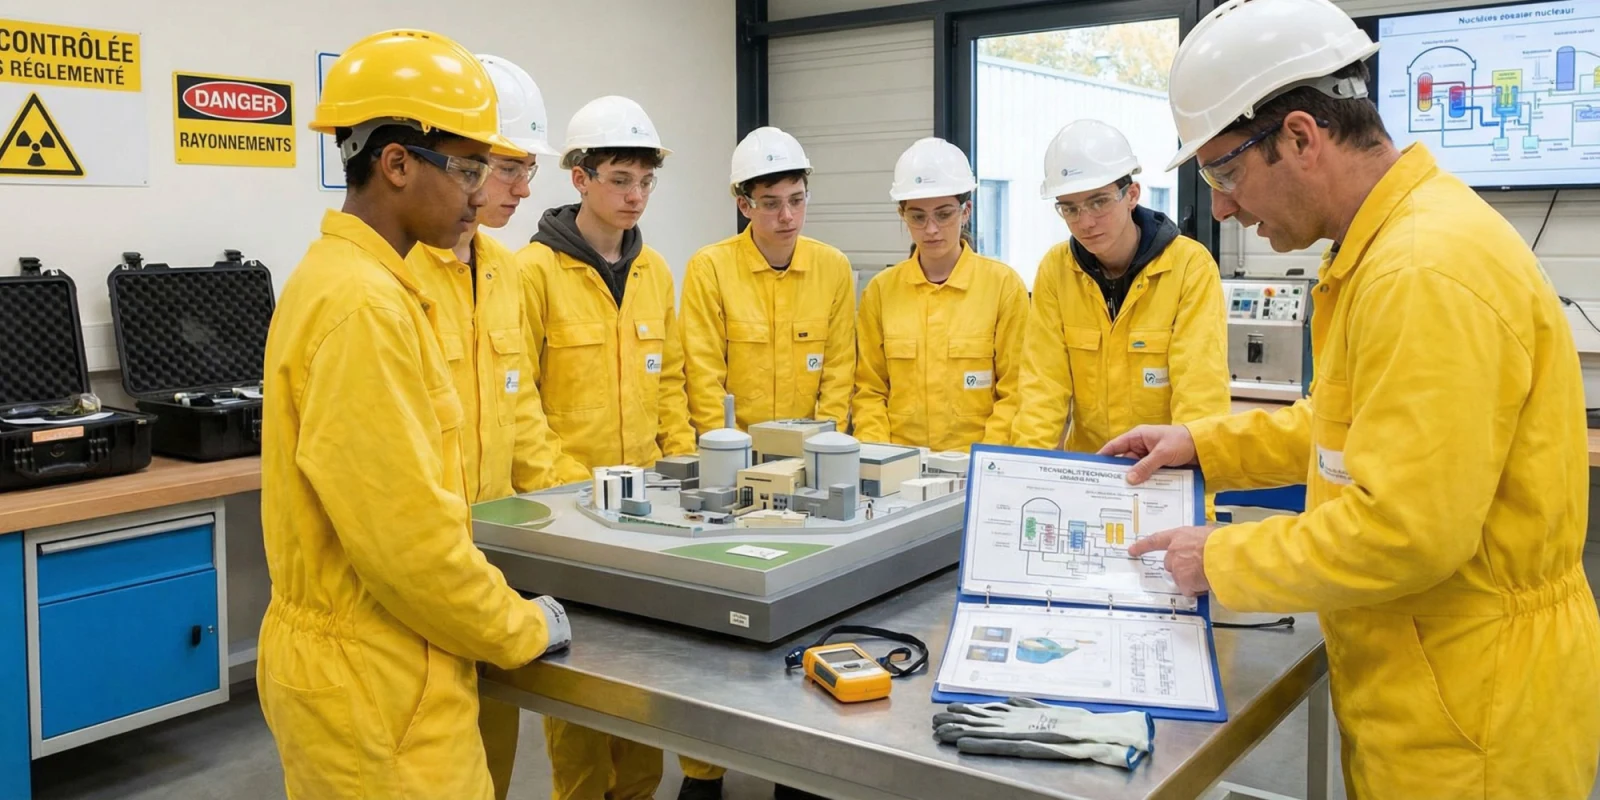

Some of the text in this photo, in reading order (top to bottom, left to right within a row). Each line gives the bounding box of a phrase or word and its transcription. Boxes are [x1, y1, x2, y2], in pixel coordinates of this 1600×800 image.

[0, 28, 134, 63] CONTRÔLÉE
[10, 57, 125, 85] RÉGLEMENTÉ
[195, 90, 277, 112] DANGER
[180, 132, 292, 152] RAYONNEMENTS
